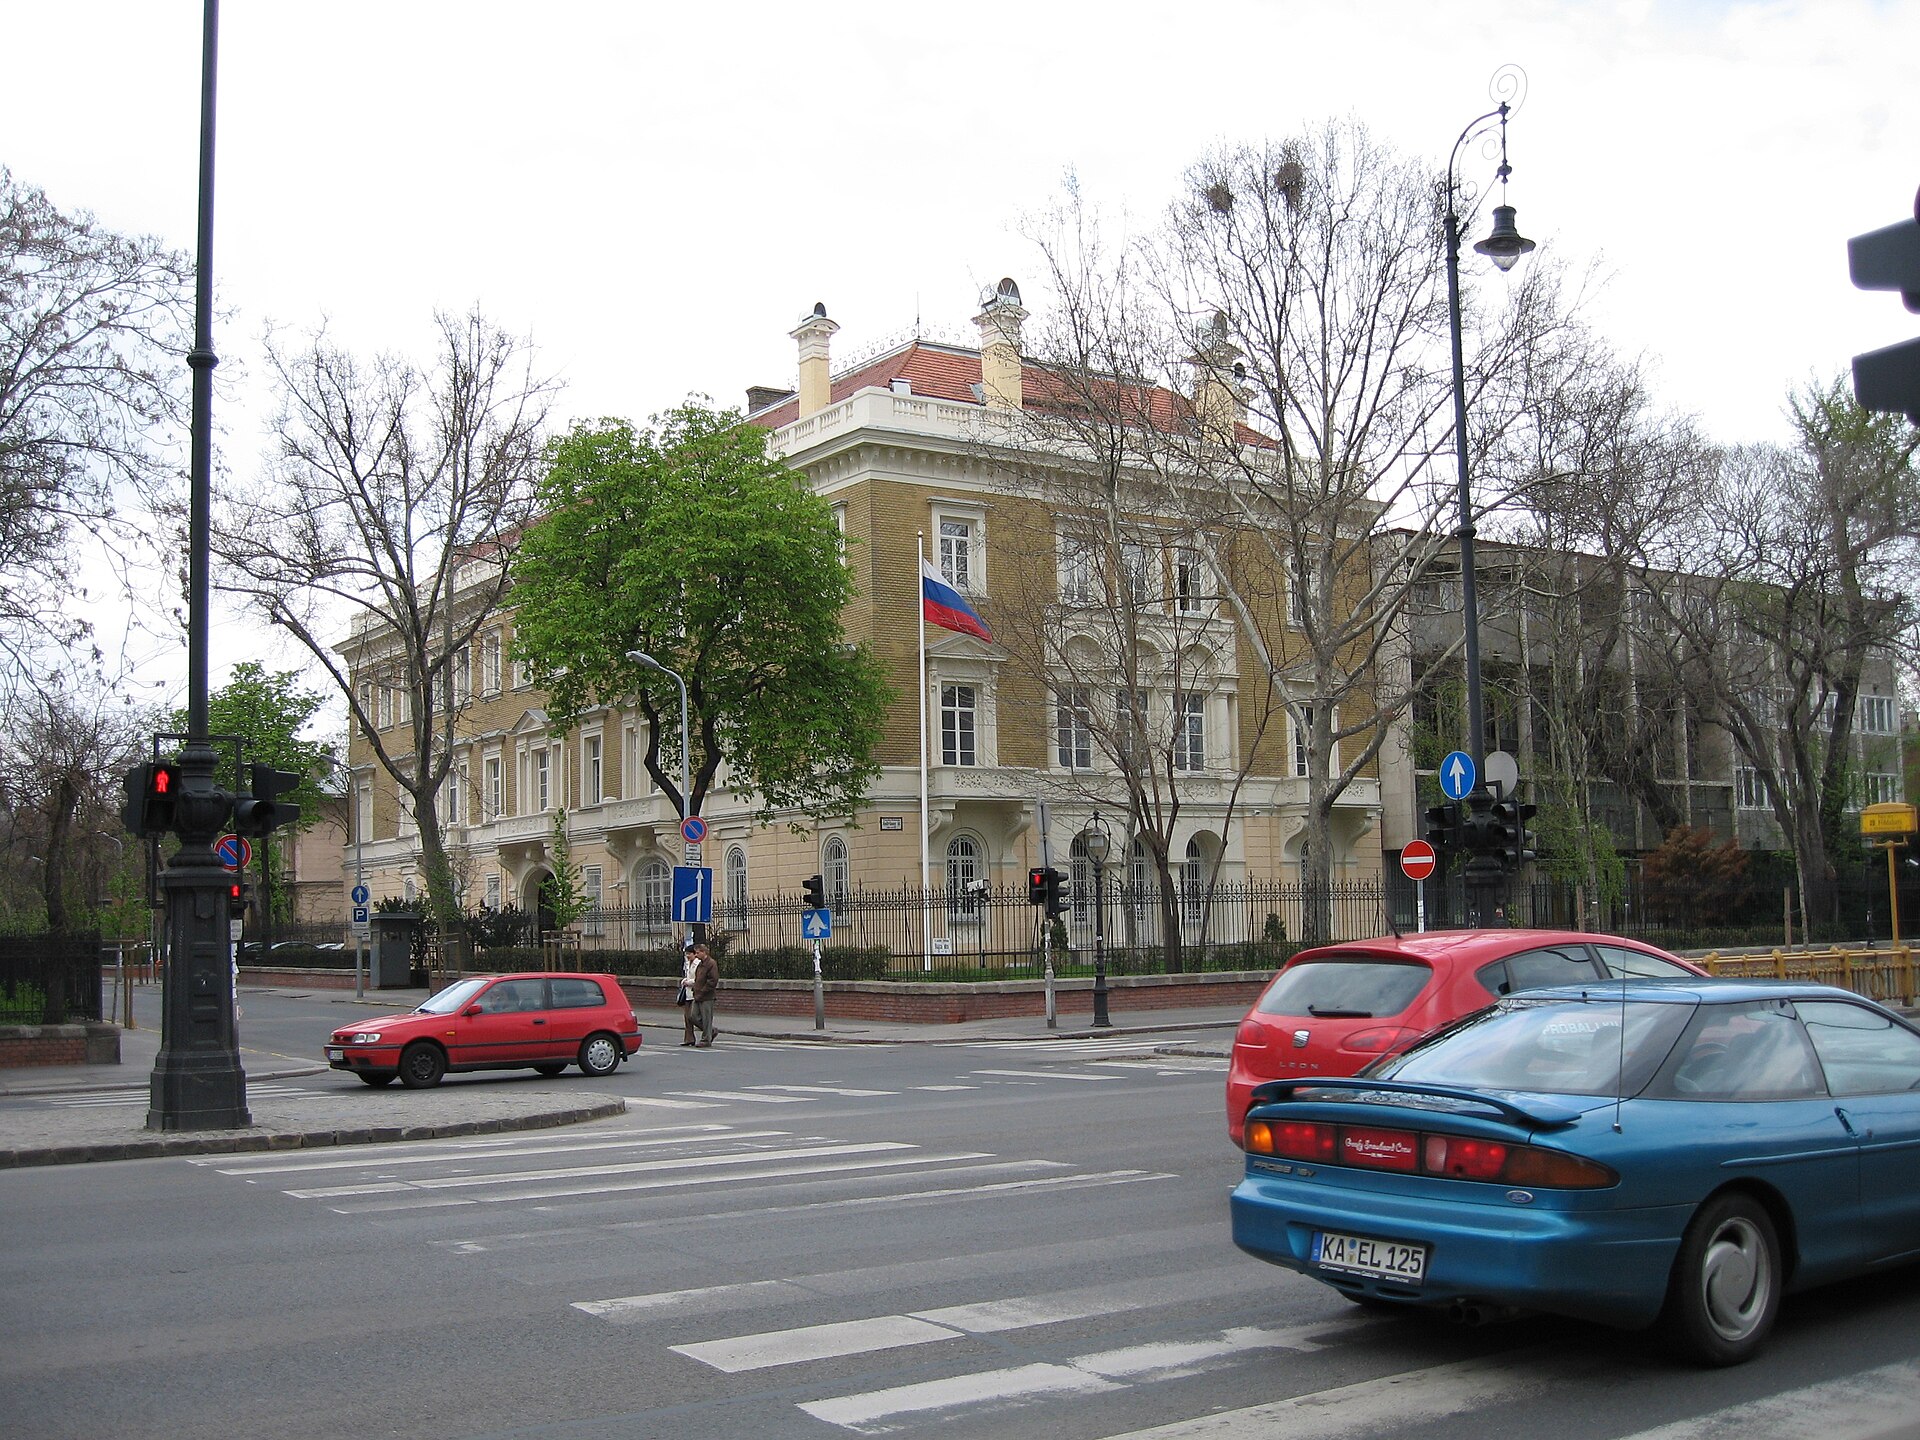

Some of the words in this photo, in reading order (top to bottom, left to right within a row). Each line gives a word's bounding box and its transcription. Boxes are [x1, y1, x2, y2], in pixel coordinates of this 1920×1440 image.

[1280, 1061, 1319, 1070] LEON
[1322, 1236, 1345, 1262] KA
[1358, 1241, 1381, 1268] EL
[1385, 1246, 1423, 1273] 125
